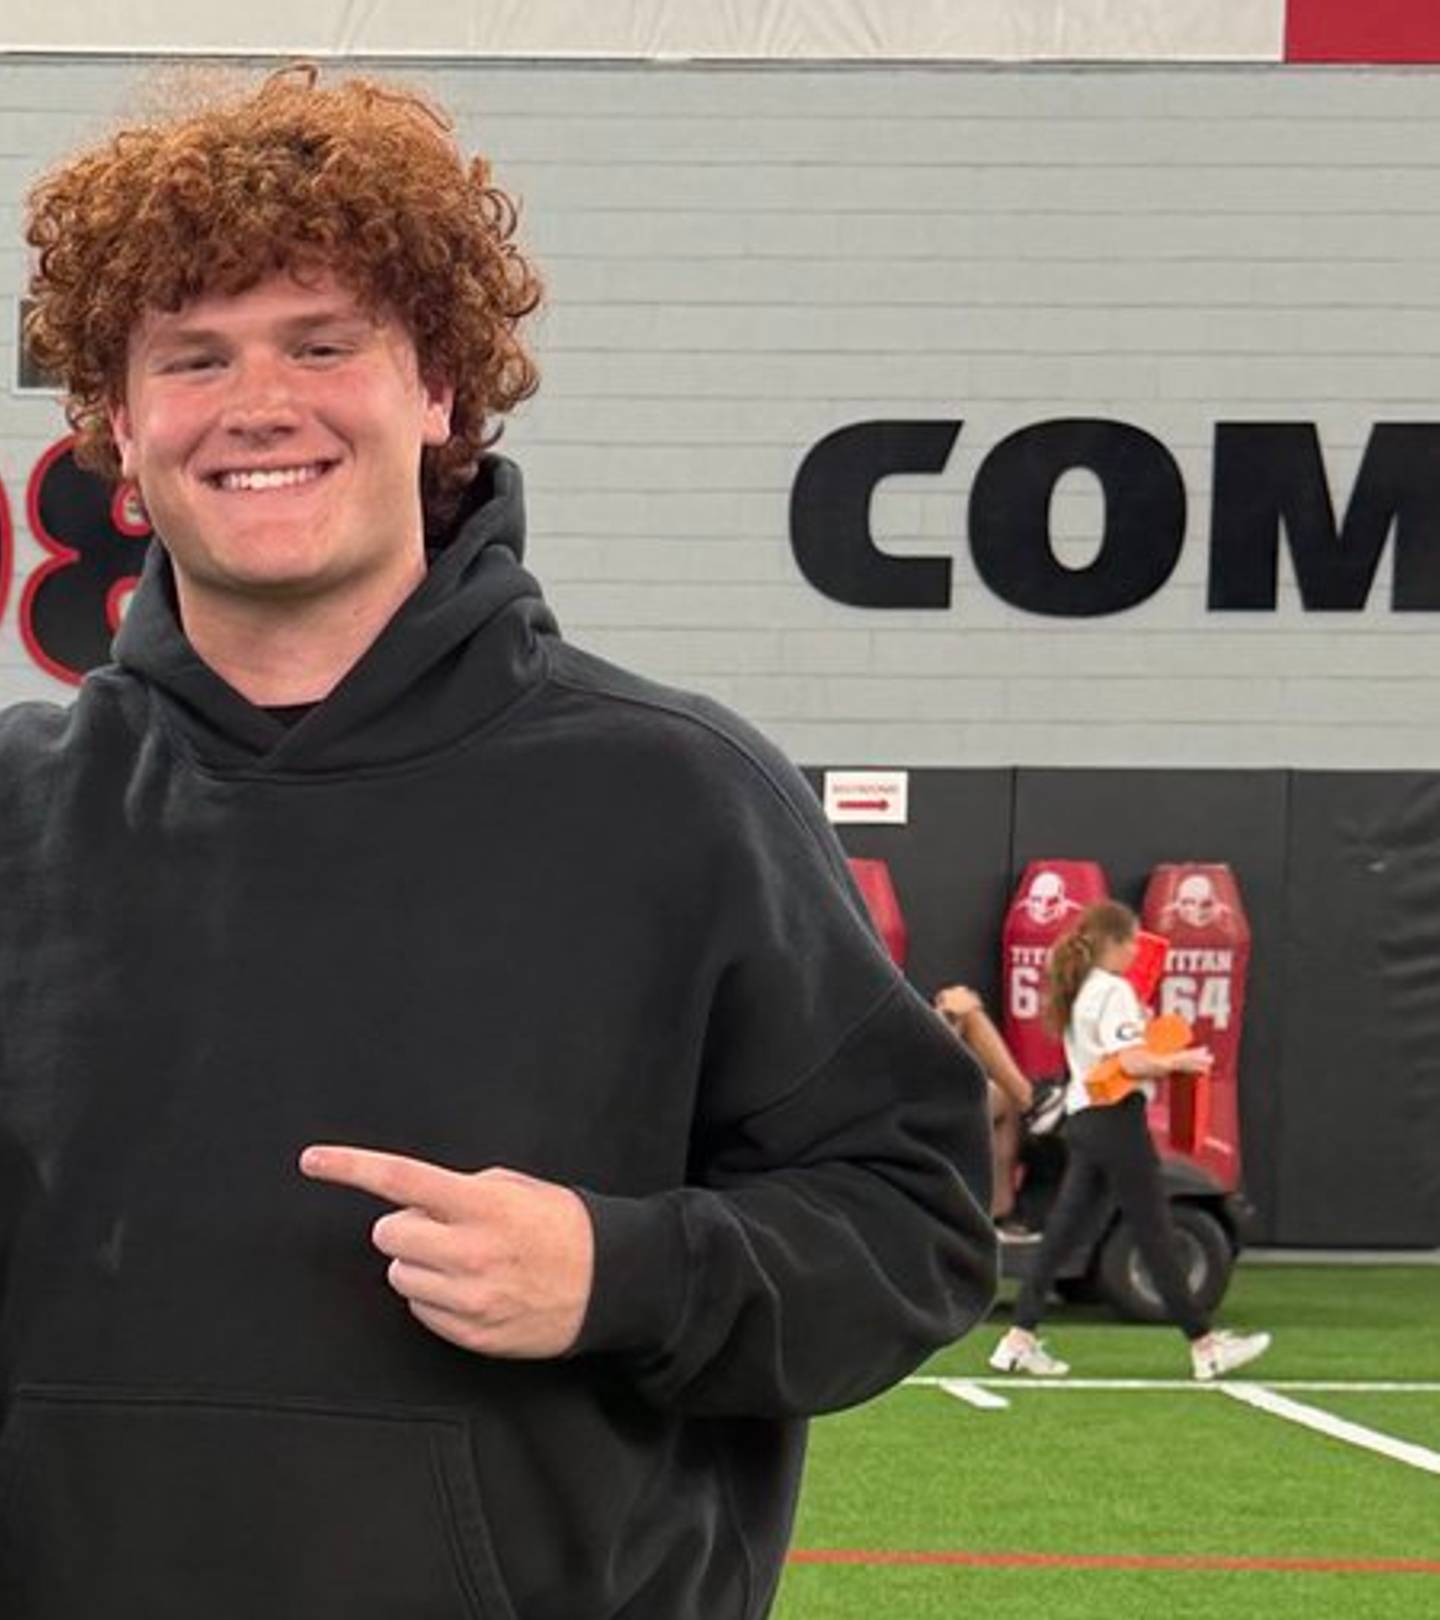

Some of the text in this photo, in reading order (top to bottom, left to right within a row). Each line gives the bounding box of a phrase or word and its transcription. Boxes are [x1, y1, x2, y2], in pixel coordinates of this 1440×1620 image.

[1163, 949, 1232, 972] TITAN
[1012, 966, 1040, 1019] 6
[1160, 976, 1231, 1030] 64
